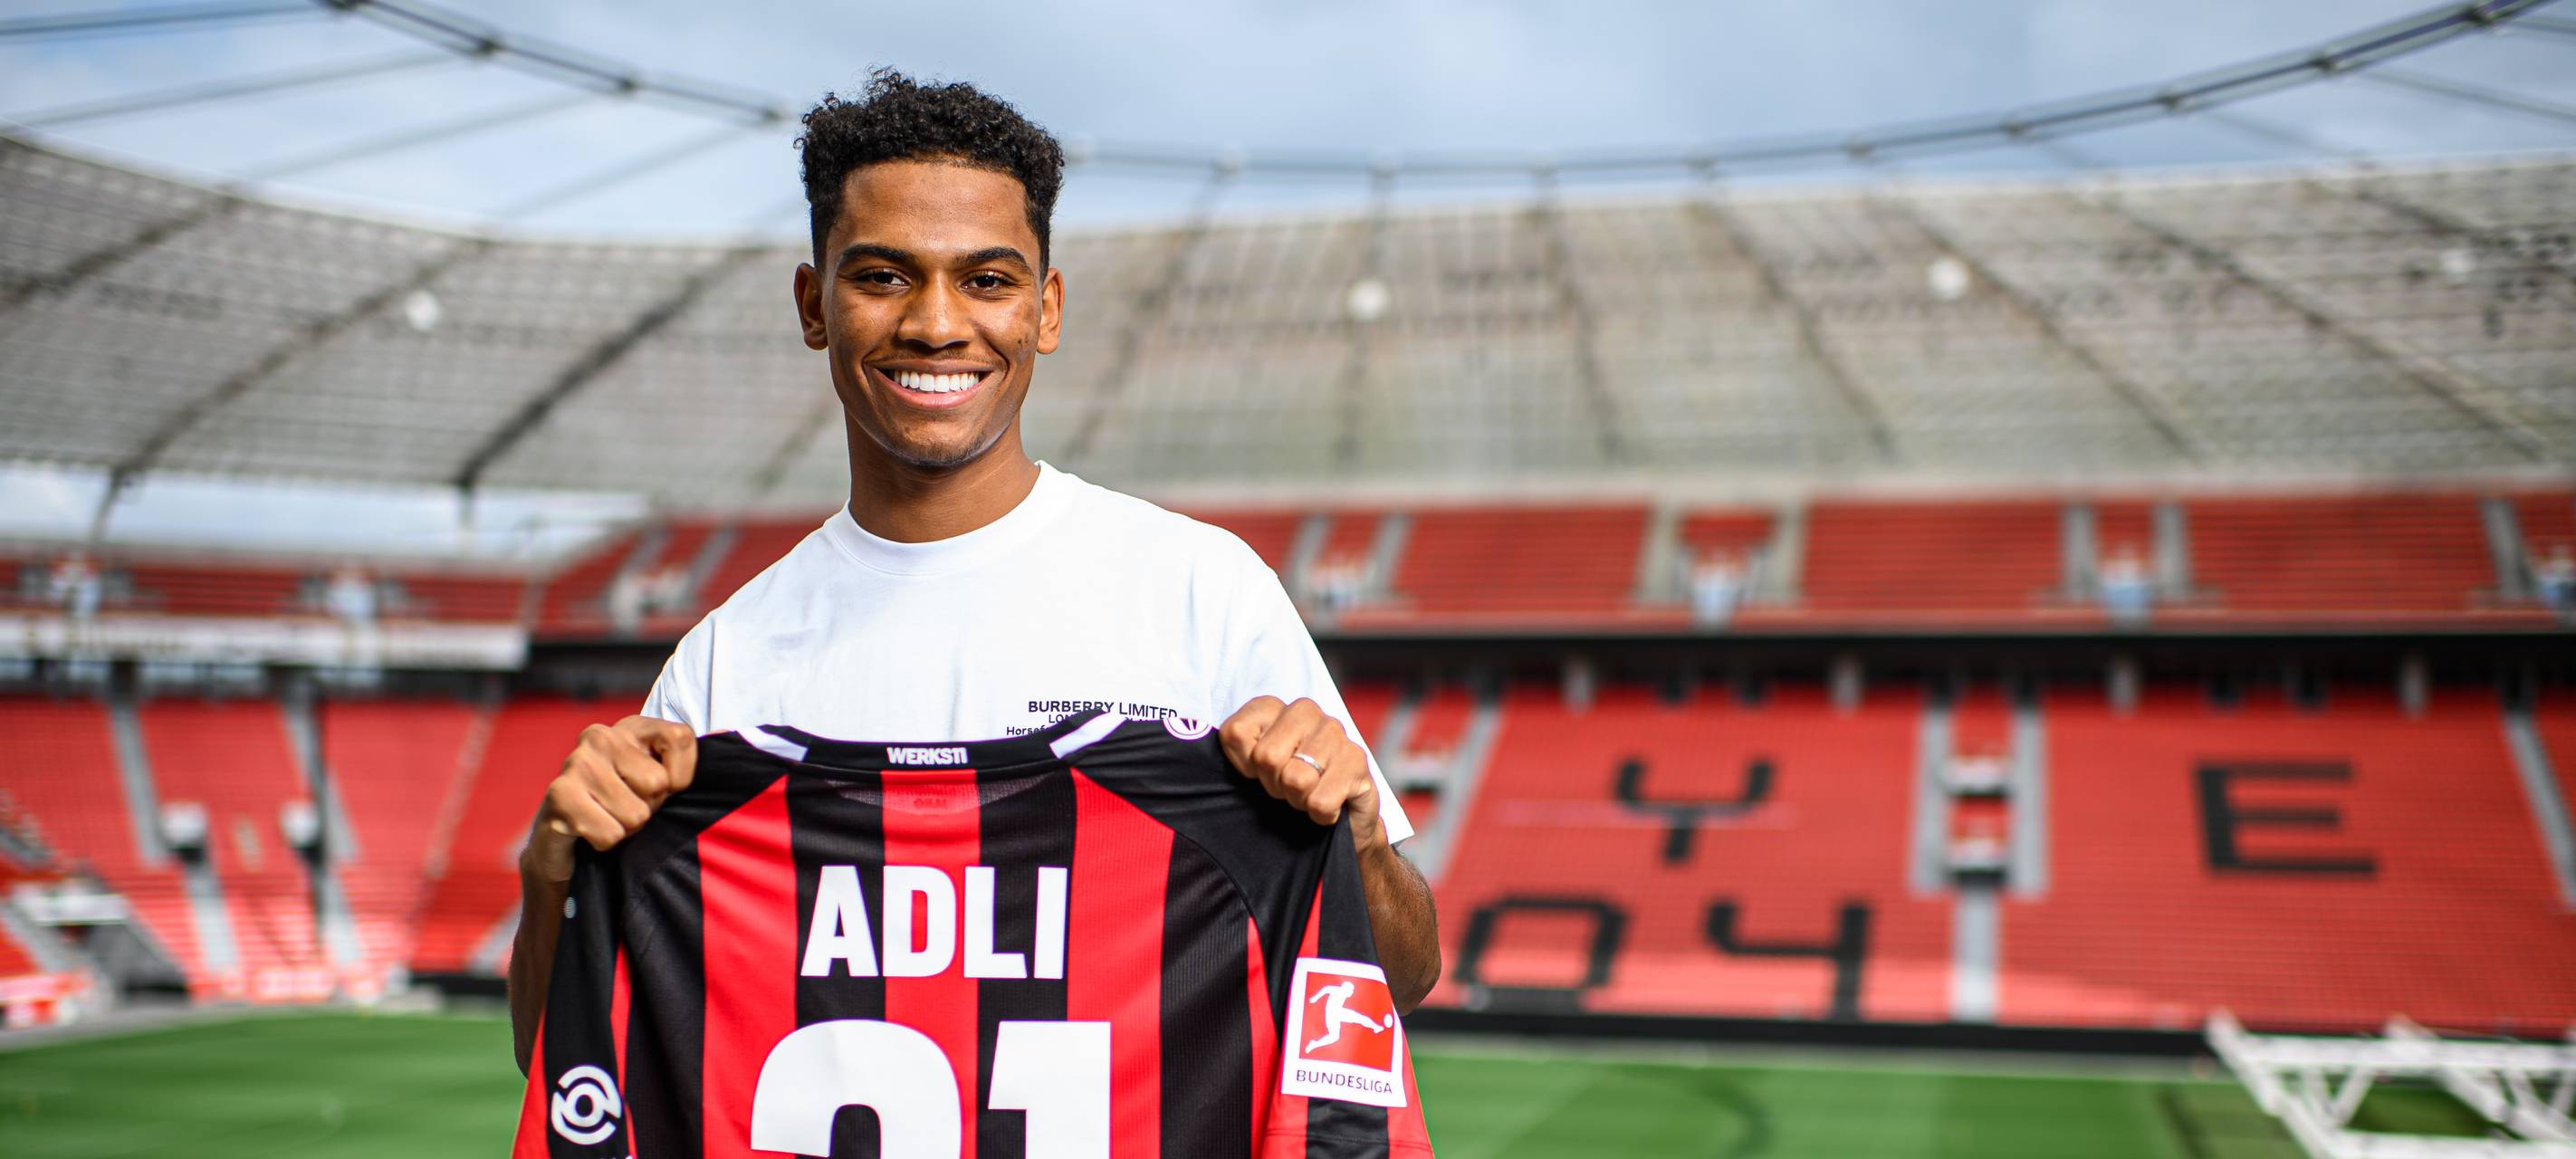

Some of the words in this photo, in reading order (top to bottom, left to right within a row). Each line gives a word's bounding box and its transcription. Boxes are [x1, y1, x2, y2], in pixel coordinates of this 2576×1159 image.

[1028, 700, 1115, 713] BURBERRY
[1118, 702, 1178, 719] LIMITED
[1614, 758, 1776, 866] Y
[2195, 759, 2380, 878] E
[800, 865, 1068, 979] ADLI
[1452, 895, 1872, 1020] 04
[1296, 1068, 1393, 1094] BUNDESLIGA
